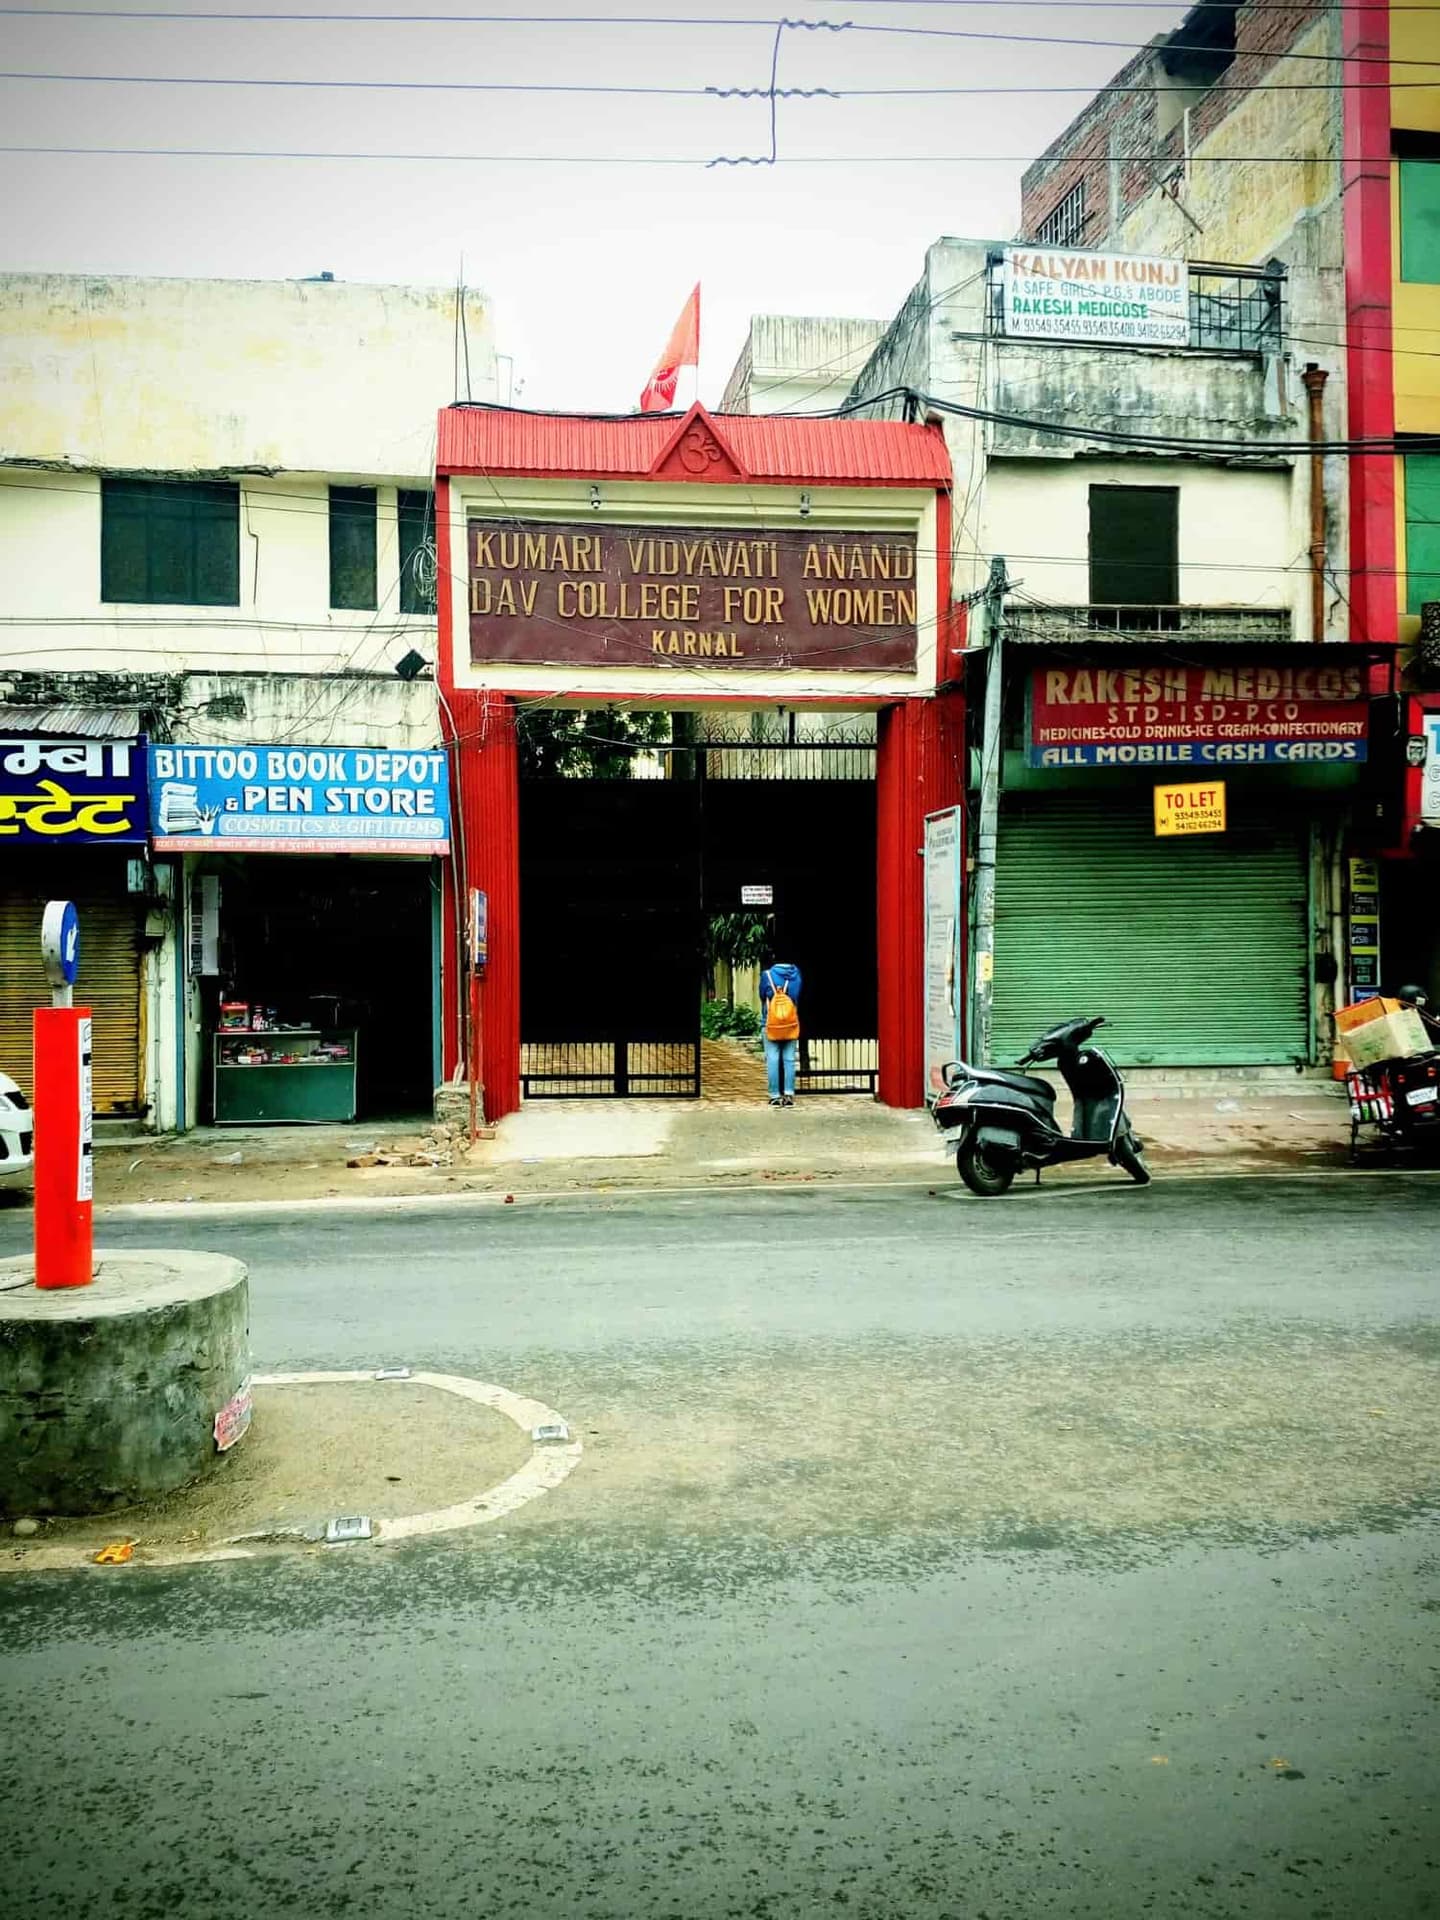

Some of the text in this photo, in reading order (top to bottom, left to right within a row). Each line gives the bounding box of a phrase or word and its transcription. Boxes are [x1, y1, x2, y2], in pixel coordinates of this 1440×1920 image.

[1012, 254, 1179, 286] KALYAN KUNJ
[1011, 280, 1019, 294] A
[1024, 281, 1053, 296] SAFE
[1060, 282, 1097, 297] GIRLS
[1139, 287, 1182, 303] ABODE
[1012, 298, 1149, 318] RAKESH MEDICOSE
[475, 531, 914, 580] KUMARI VIDYAVATI ANAND
[470, 577, 917, 625] DAV COLLEGE FOR WOMEN
[652, 629, 745, 657] KARNAL
[1045, 668, 1362, 704] RAKESH MEDICOS
[155, 749, 444, 785] BITTOO BOOK DEPOT
[1042, 741, 1357, 766] ALL MOBILE CASH CARDS
[224, 785, 436, 816] & PEN STORE
[1164, 790, 1217, 809] TO LET
[225, 818, 441, 835] COSMETICS & GIFT ITEMS
